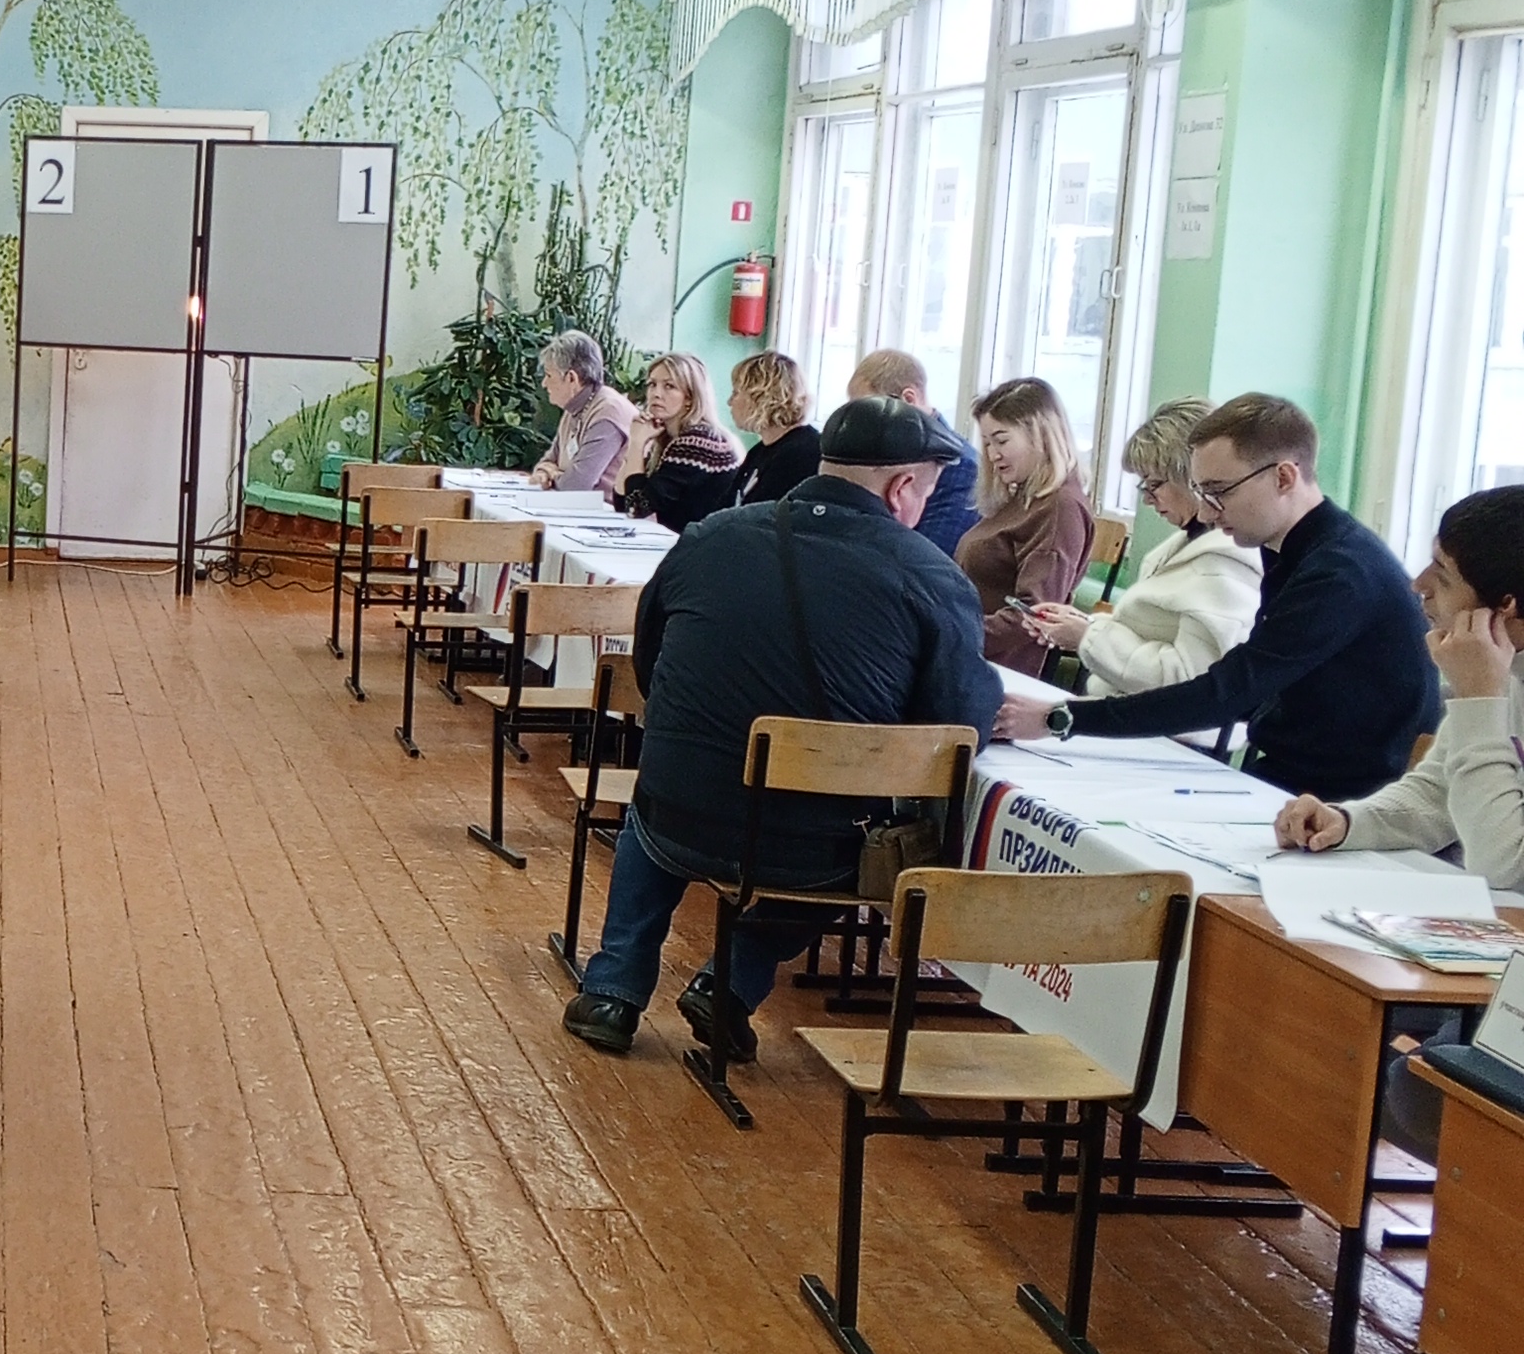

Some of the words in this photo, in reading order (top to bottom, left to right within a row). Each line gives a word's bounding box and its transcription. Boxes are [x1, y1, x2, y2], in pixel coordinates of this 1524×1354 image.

[38, 158, 65, 205] 2
[357, 166, 376, 215] 1
[1039, 963, 1072, 1002] 2024
